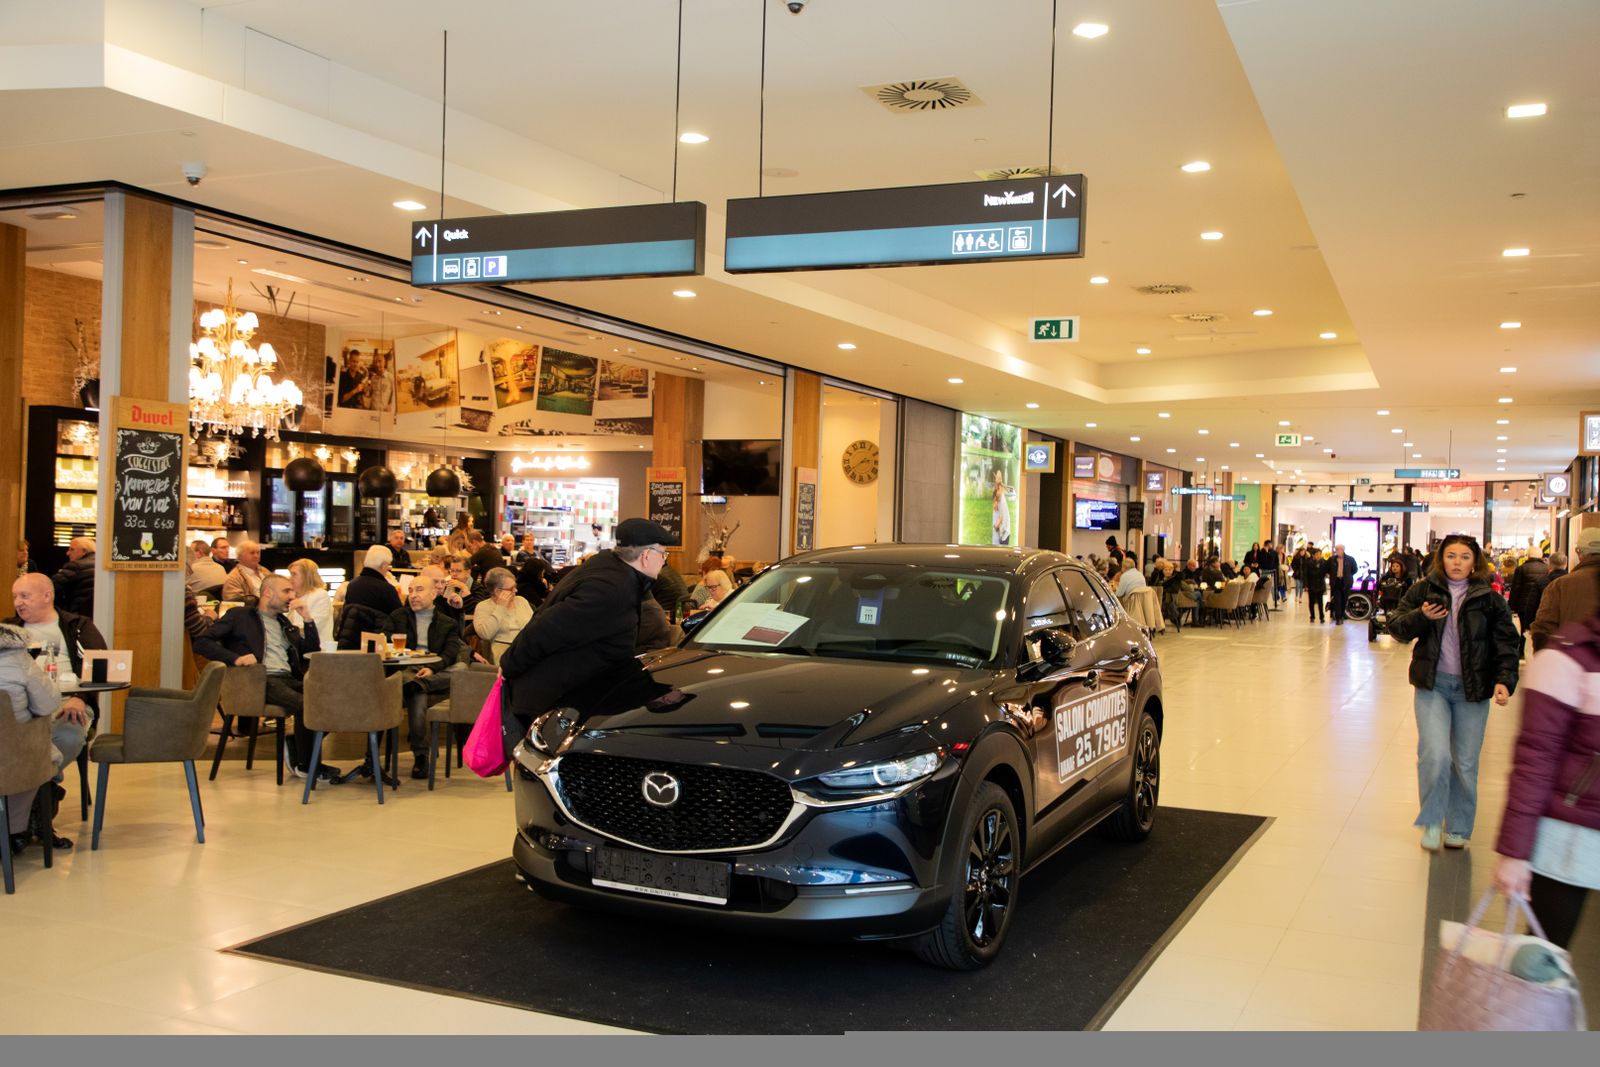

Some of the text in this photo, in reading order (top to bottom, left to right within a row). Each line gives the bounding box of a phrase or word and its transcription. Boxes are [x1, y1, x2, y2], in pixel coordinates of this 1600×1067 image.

[442, 228, 470, 242] Quick
[131, 405, 174, 426] Duvel
[1056, 689, 1126, 742] SALON CONDITIES
